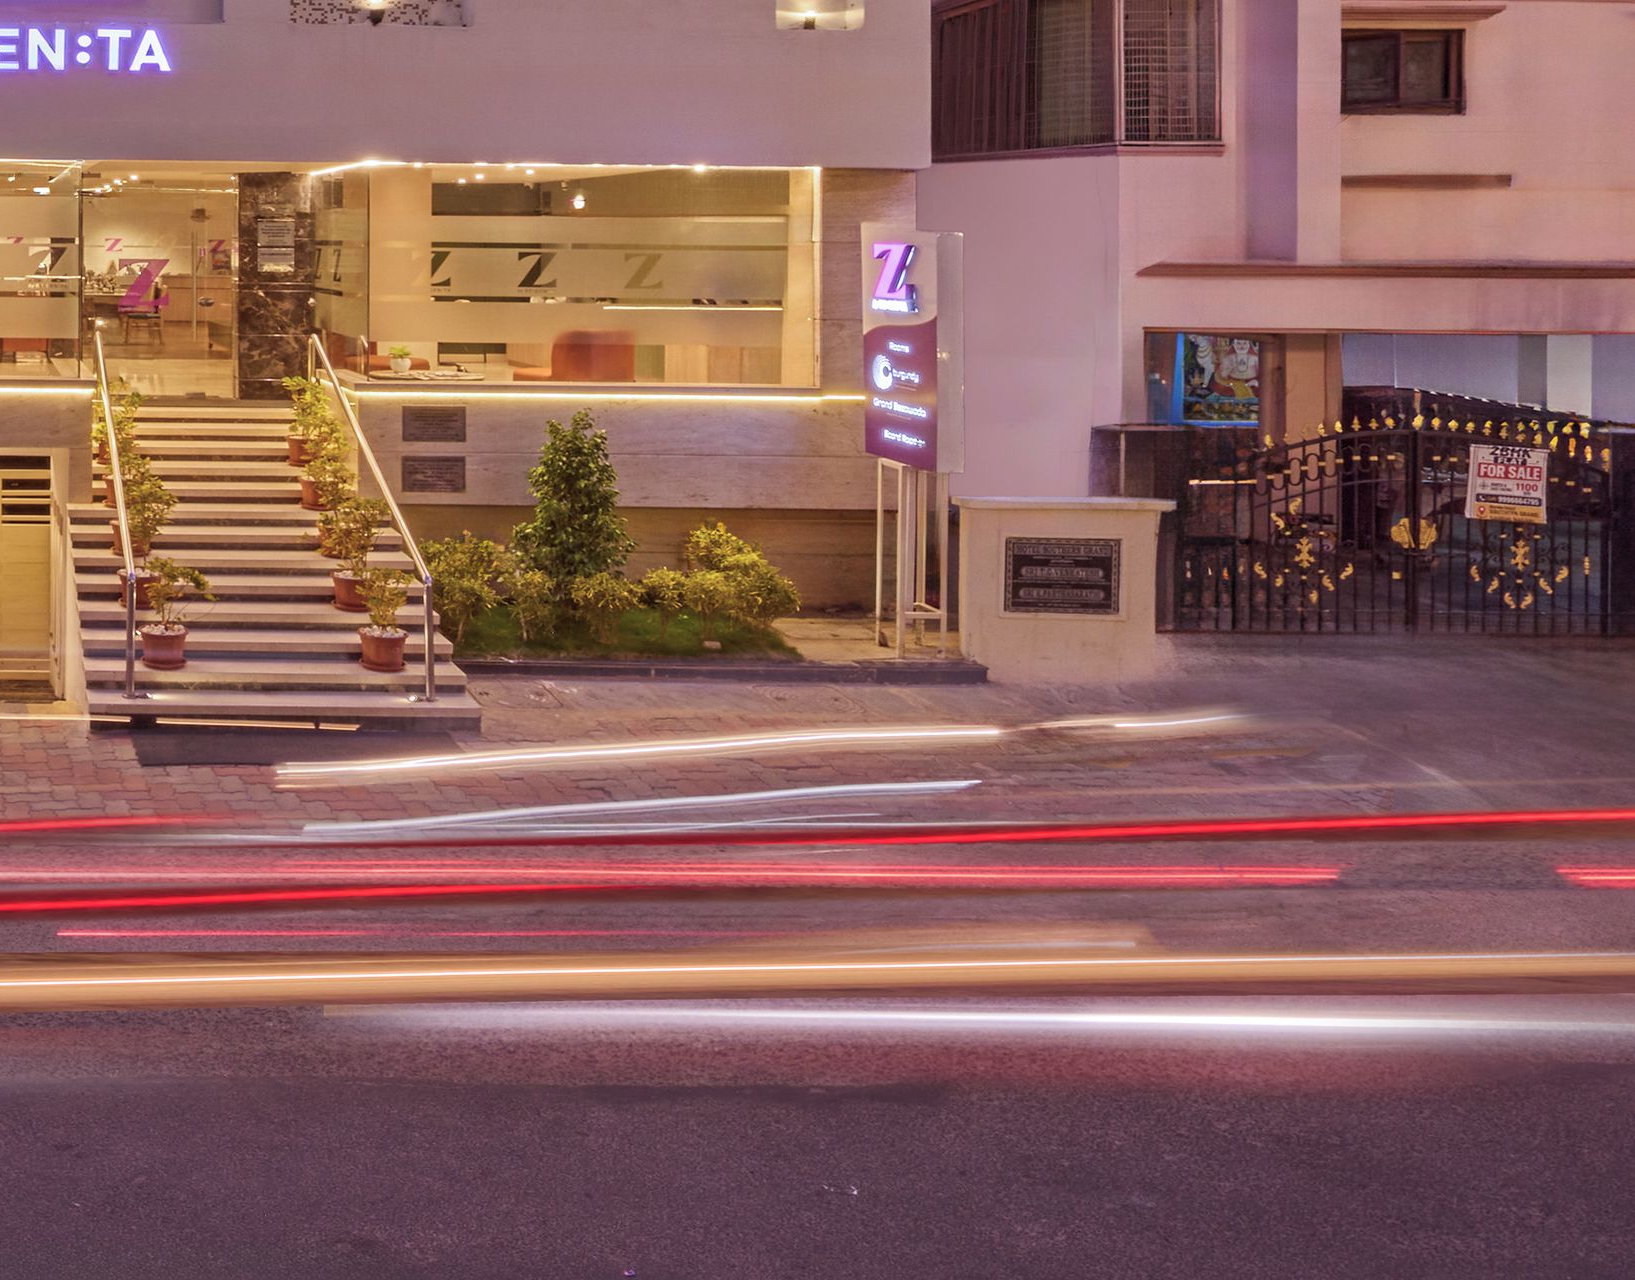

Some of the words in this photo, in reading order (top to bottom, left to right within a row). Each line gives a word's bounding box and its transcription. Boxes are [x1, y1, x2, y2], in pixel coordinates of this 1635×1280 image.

[118, 258, 170, 307] Z
[518, 252, 557, 288] Z
[623, 253, 663, 289] Z
[872, 242, 916, 300] Z
[1479, 464, 1506, 477] FOR
[1507, 466, 1541, 480] SALE
[1497, 458, 1523, 466] FLAT
[1516, 483, 1539, 492] 1100
[1016, 544, 1042, 554] HOTEL
